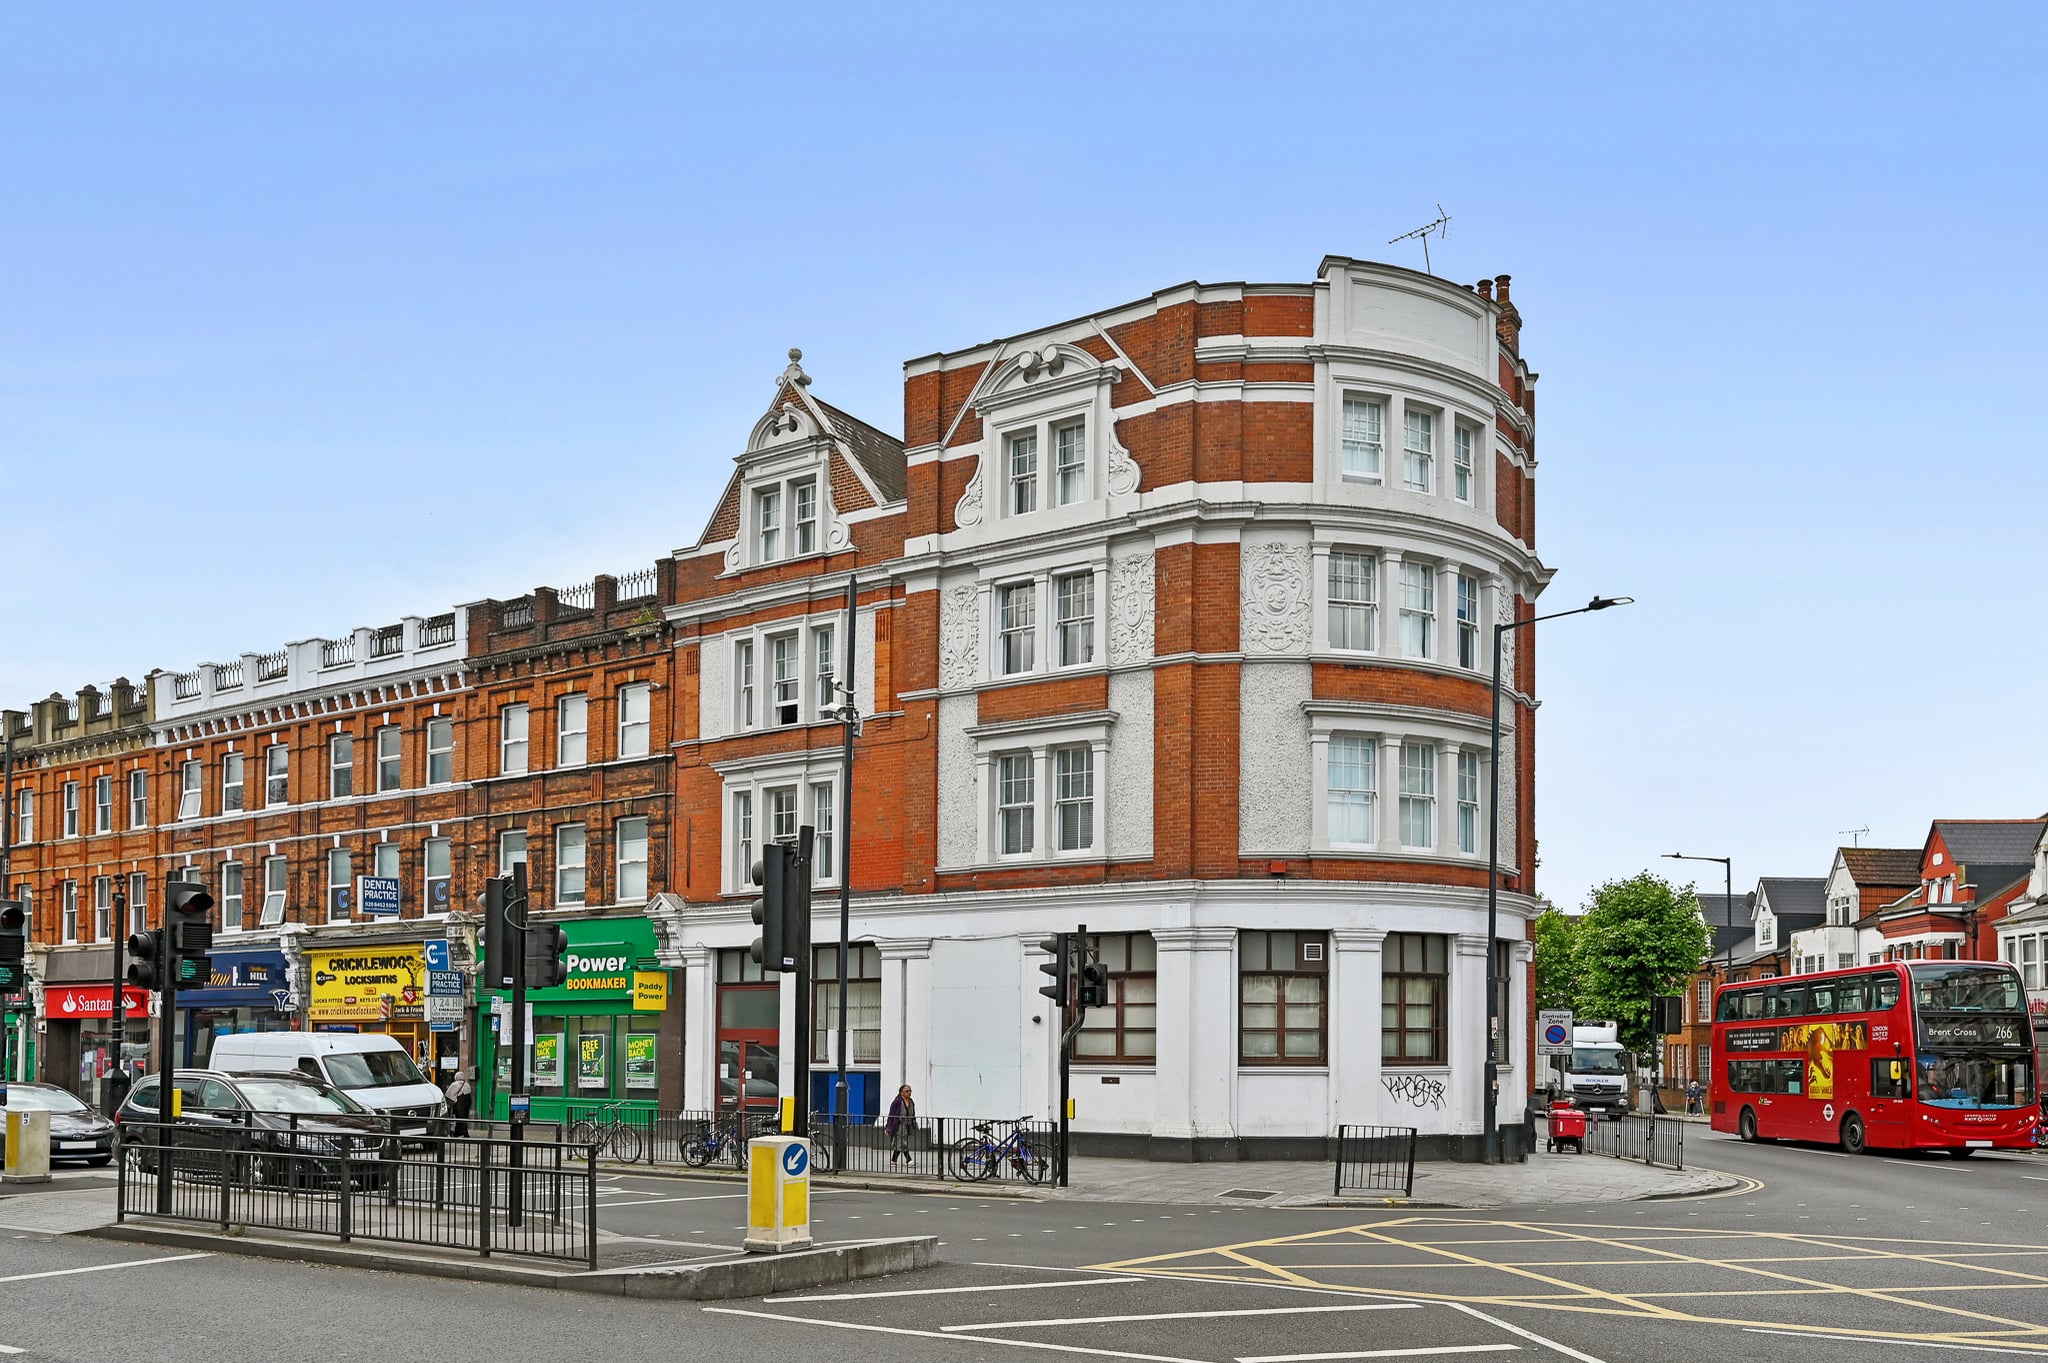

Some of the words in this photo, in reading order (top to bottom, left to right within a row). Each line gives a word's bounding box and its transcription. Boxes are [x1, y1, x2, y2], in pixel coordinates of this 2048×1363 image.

[364, 879, 398, 891] DENTAL
[364, 889, 398, 900] PRACTICE
[567, 954, 627, 973] Power
[249, 972, 268, 980] HILL
[344, 974, 398, 985] LOCKSMITHS
[431, 972, 461, 981] DENTAL
[431, 980, 461, 988] PRACTICE
[567, 977, 627, 990] BOOKMAKER
[638, 982, 663, 991] Paddy
[638, 992, 663, 1000] Power
[78, 994, 113, 1011] Santan
[1928, 1027, 1951, 1036] Brent
[1953, 1028, 1977, 1036] Cross
[1995, 1025, 2013, 1039] 266
[536, 1039, 557, 1049] MONEY
[581, 1039, 599, 1050] FREE
[628, 1038, 654, 1049] MONEY
[537, 1047, 551, 1056] BACK
[628, 1047, 646, 1057] BACK
